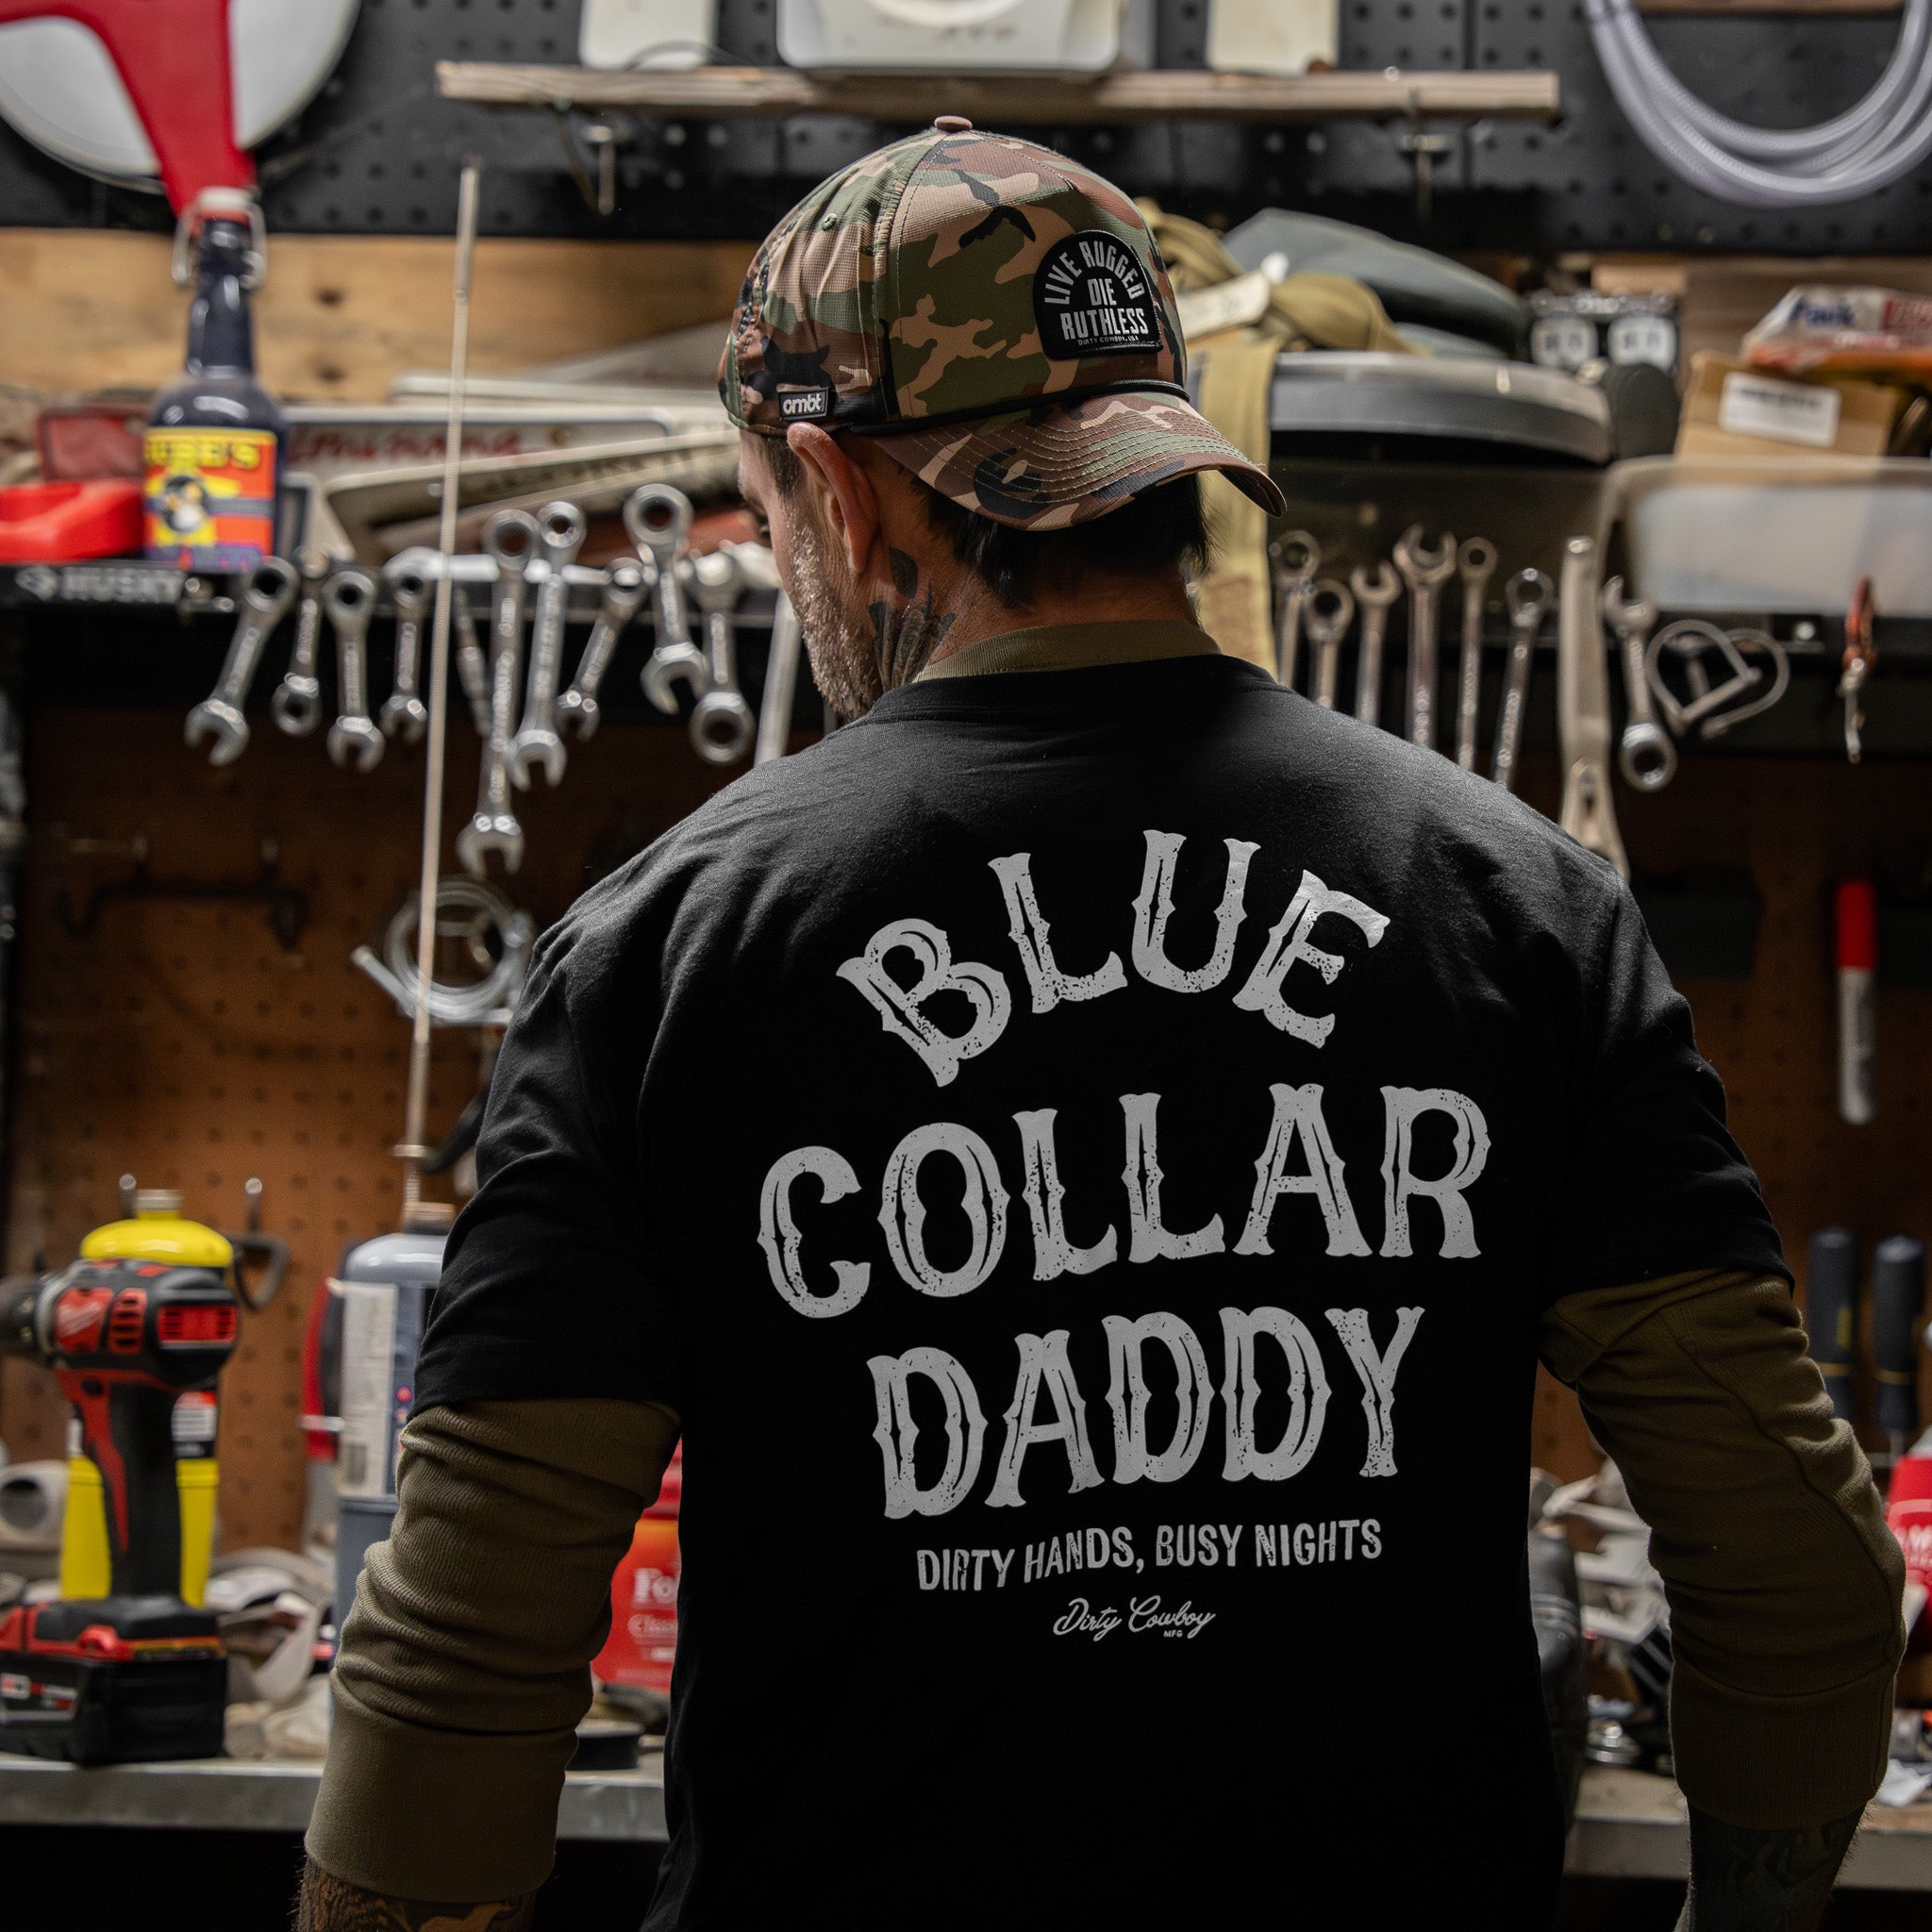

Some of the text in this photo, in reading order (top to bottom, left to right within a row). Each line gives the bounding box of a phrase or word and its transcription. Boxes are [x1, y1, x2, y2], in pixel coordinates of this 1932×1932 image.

[1044, 241, 1145, 305] LIVE RUGGED
[1087, 278, 1117, 306] DIE
[1059, 308, 1149, 341] RUTHLESS
[836, 830, 1391, 1088] BLUE
[758, 1083, 1491, 1319] COLLAR
[867, 1307, 1425, 1520] DADDY
[917, 1519, 1382, 1591] DIRTY HANDS, BUSY NIGHTS
[1053, 1594, 1217, 1642] Dirty Cowboy
[1163, 1629, 1183, 1638] MFG
